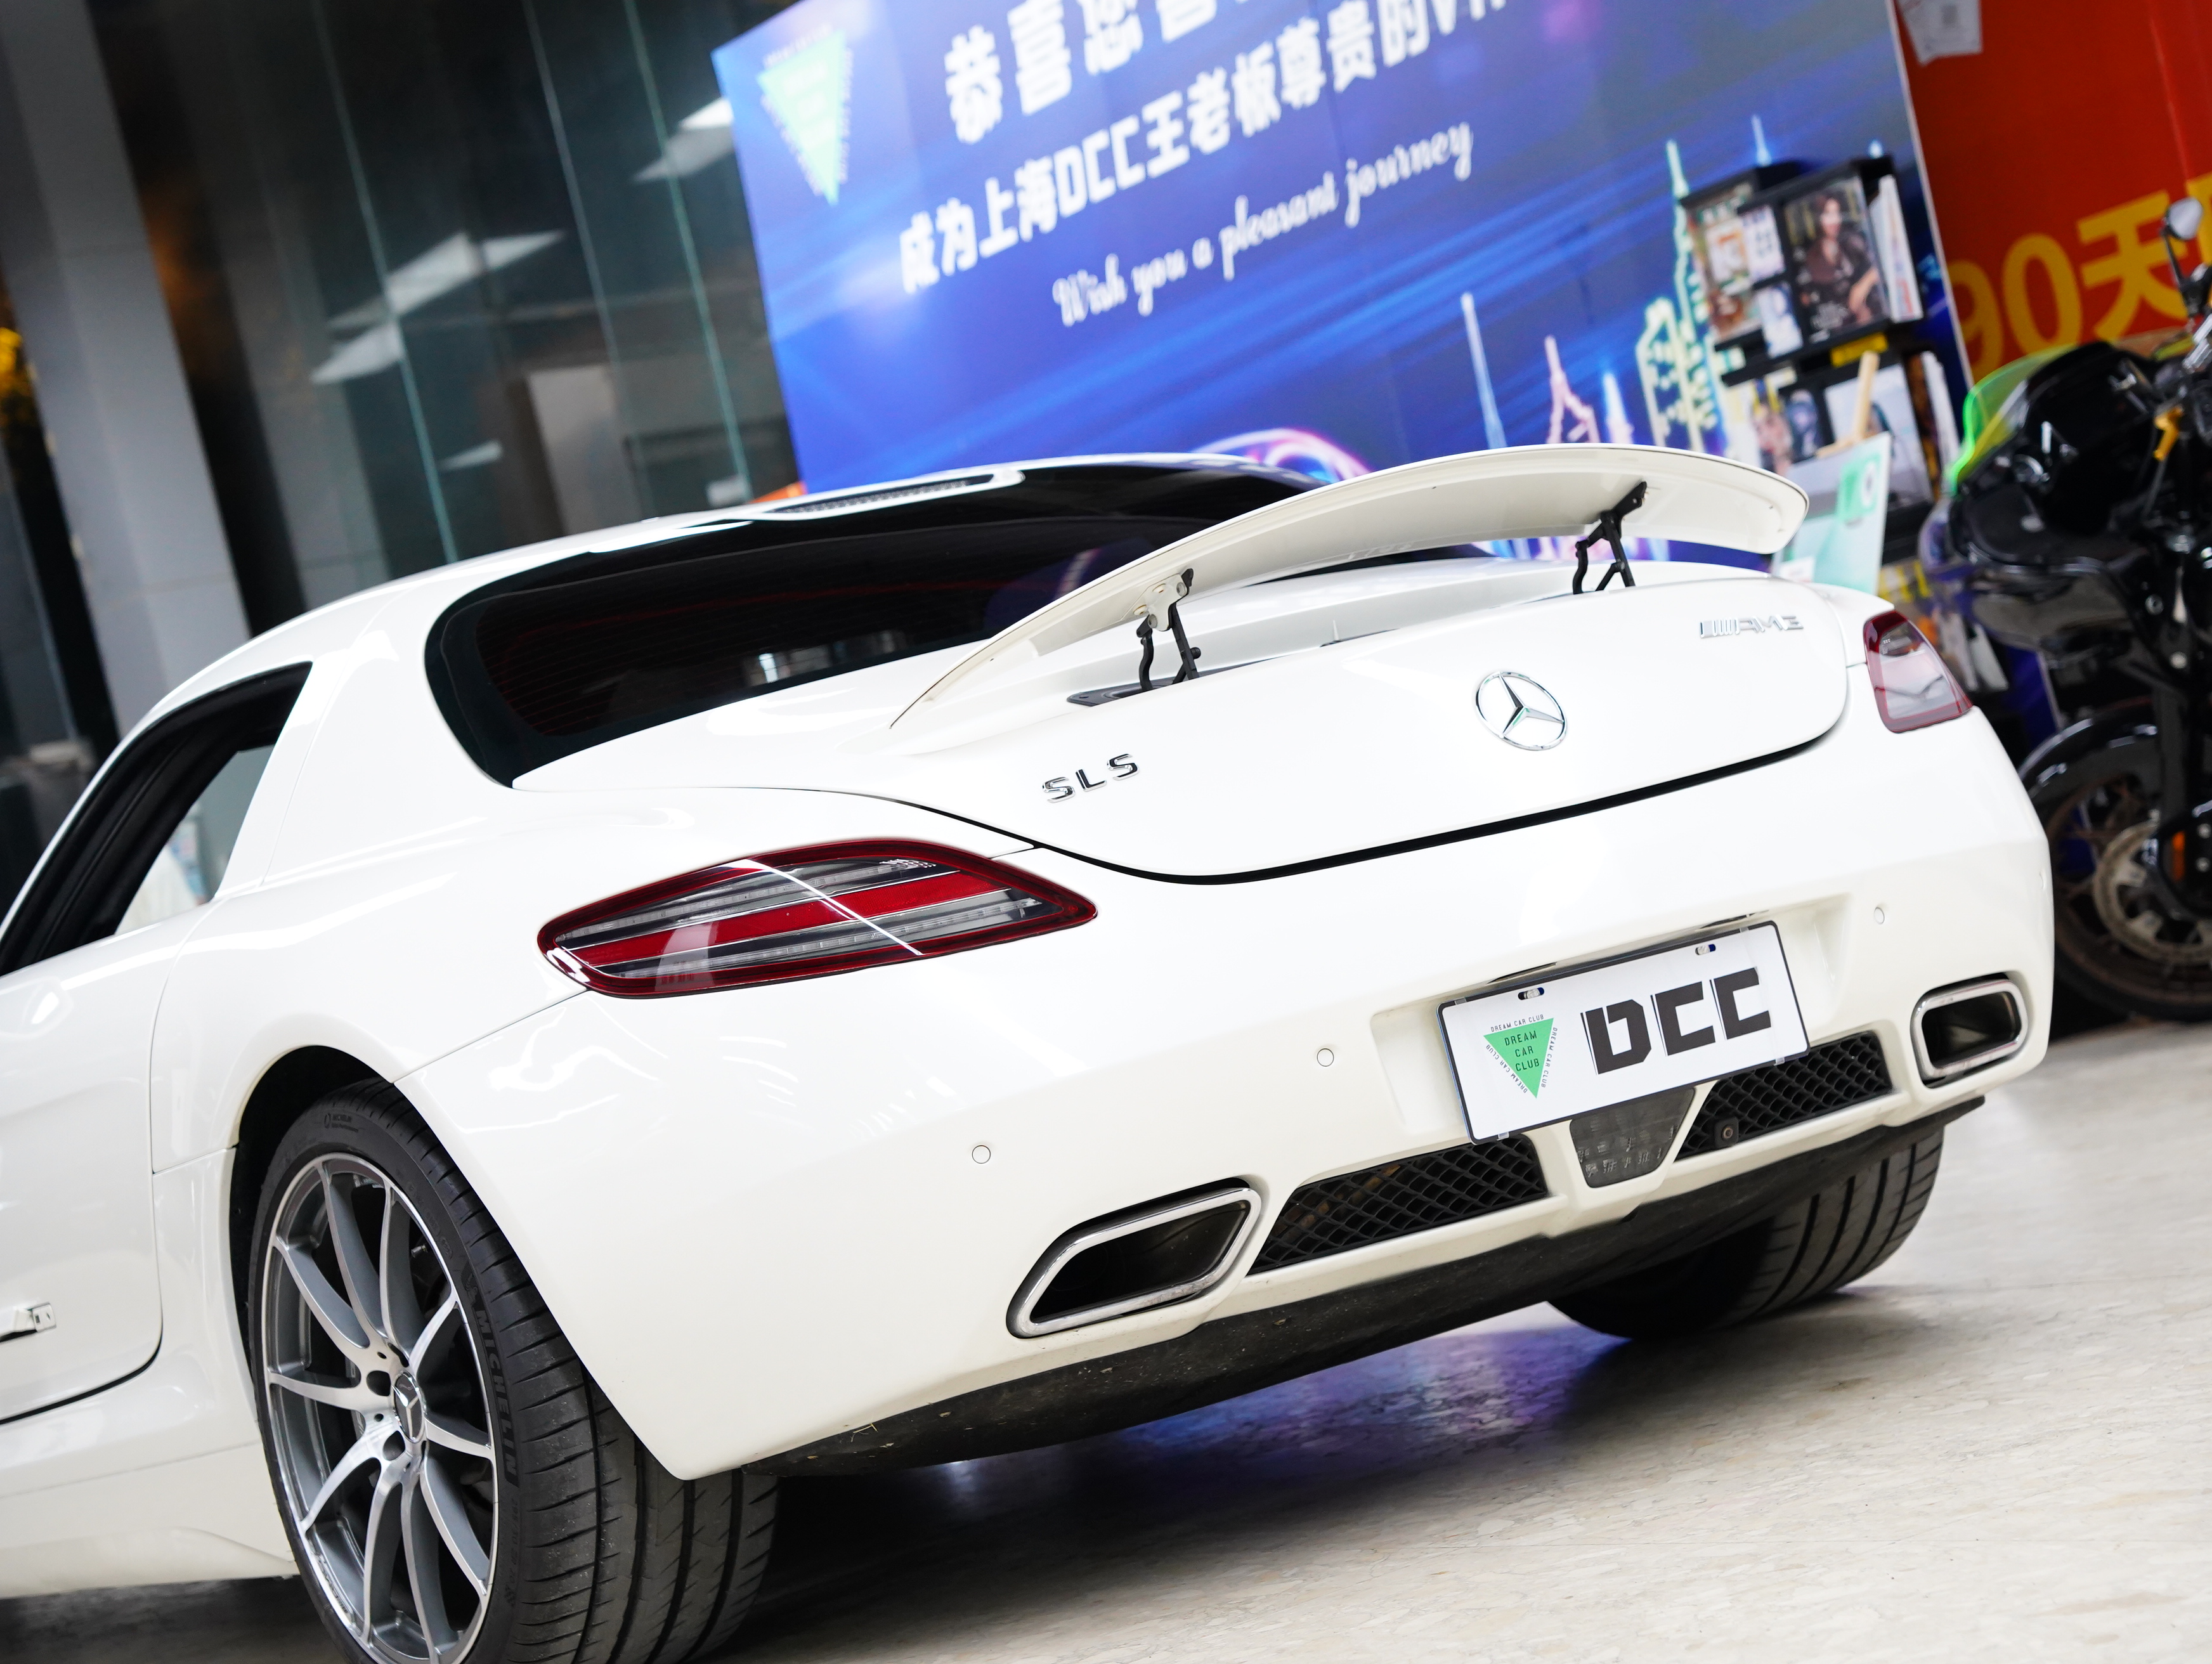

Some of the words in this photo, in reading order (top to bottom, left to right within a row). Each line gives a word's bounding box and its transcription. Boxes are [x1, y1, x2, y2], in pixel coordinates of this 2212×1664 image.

[899, 0, 1507, 294] 成为上海DCC王老板尊贵的
[1052, 254, 1127, 327] Wish
[1131, 249, 1187, 316] you
[1192, 237, 1214, 270] a
[1219, 171, 1339, 281] pleasant
[1344, 122, 1473, 228] journey
[1947, 170, 2212, 382] 90天
[1042, 753, 1140, 803] SLS
[1490, 1022, 1512, 1032] DREAM
[1514, 1018, 1526, 1027] CAR
[1528, 1014, 1544, 1023] CLUB
[1580, 967, 1771, 1075] DCC
[1504, 1030, 1537, 1046] DREAM
[1549, 1027, 1558, 1051] DREAM
[1485, 1044, 1500, 1060] CLUB
[1515, 1046, 1533, 1057] CAR
[1499, 1060, 1511, 1072] CAR
[1515, 1058, 1540, 1072] CLUB
[1510, 1073, 1528, 1093] DREAM
[1540, 1070, 1549, 1088] CLUB
[476, 1310, 517, 1476] MICHELIN
